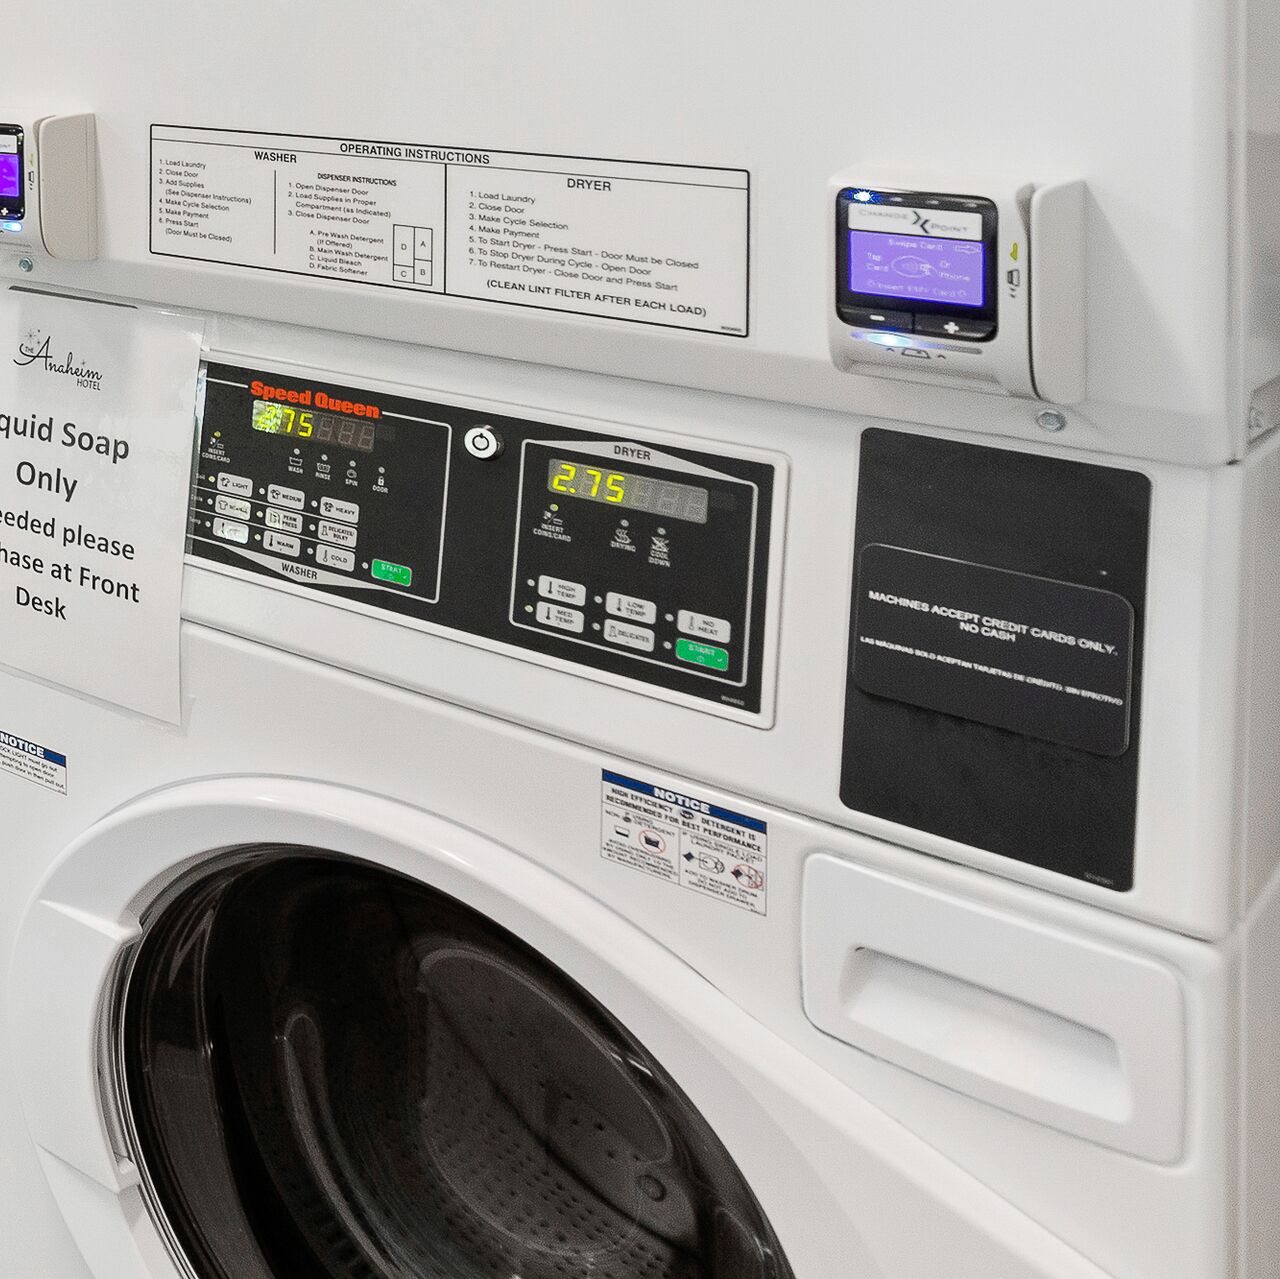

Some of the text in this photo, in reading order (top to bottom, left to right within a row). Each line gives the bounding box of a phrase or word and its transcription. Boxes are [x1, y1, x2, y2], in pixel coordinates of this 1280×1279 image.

[254, 151, 297, 163] WASHER
[340, 143, 490, 164] OPERATING INSTRUCTIONS
[567, 178, 611, 191] DRYER
[487, 279, 706, 317] (CLEAN LINT FILTER AFTER EACH LOAD)
[13, 336, 102, 380] Anaheim
[76, 378, 100, 390] HOTEL
[250, 381, 380, 418] Speed Queen
[61, 422, 129, 464] Soap
[614, 446, 651, 460] DRYER
[16, 461, 78, 502] Only
[372, 485, 388, 493] DOOR
[552, 463, 625, 502] 2.75
[336, 507, 355, 515] HEAVY
[63, 524, 134, 560] please
[610, 541, 636, 552] DRYING
[331, 555, 348, 563] COLD
[649, 557, 670, 567] DOWN
[281, 562, 318, 580] WASHER
[51, 563, 72, 583] at
[80, 566, 140, 603] Front
[556, 590, 576, 599] TEMP
[16, 586, 66, 620] Desk
[627, 601, 644, 609] LOW
[556, 609, 573, 618] MED
[626, 607, 646, 616] TEMP
[555, 616, 574, 624] TEMP
[868, 590, 1118, 656] MACHINES ACCEPT CREDIT CARDS ONLY.
[698, 626, 718, 635] HEAT
[960, 621, 1016, 642] NO CASH
[0, 732, 45, 758] NOTICE
[653, 787, 710, 814] NOTICE
